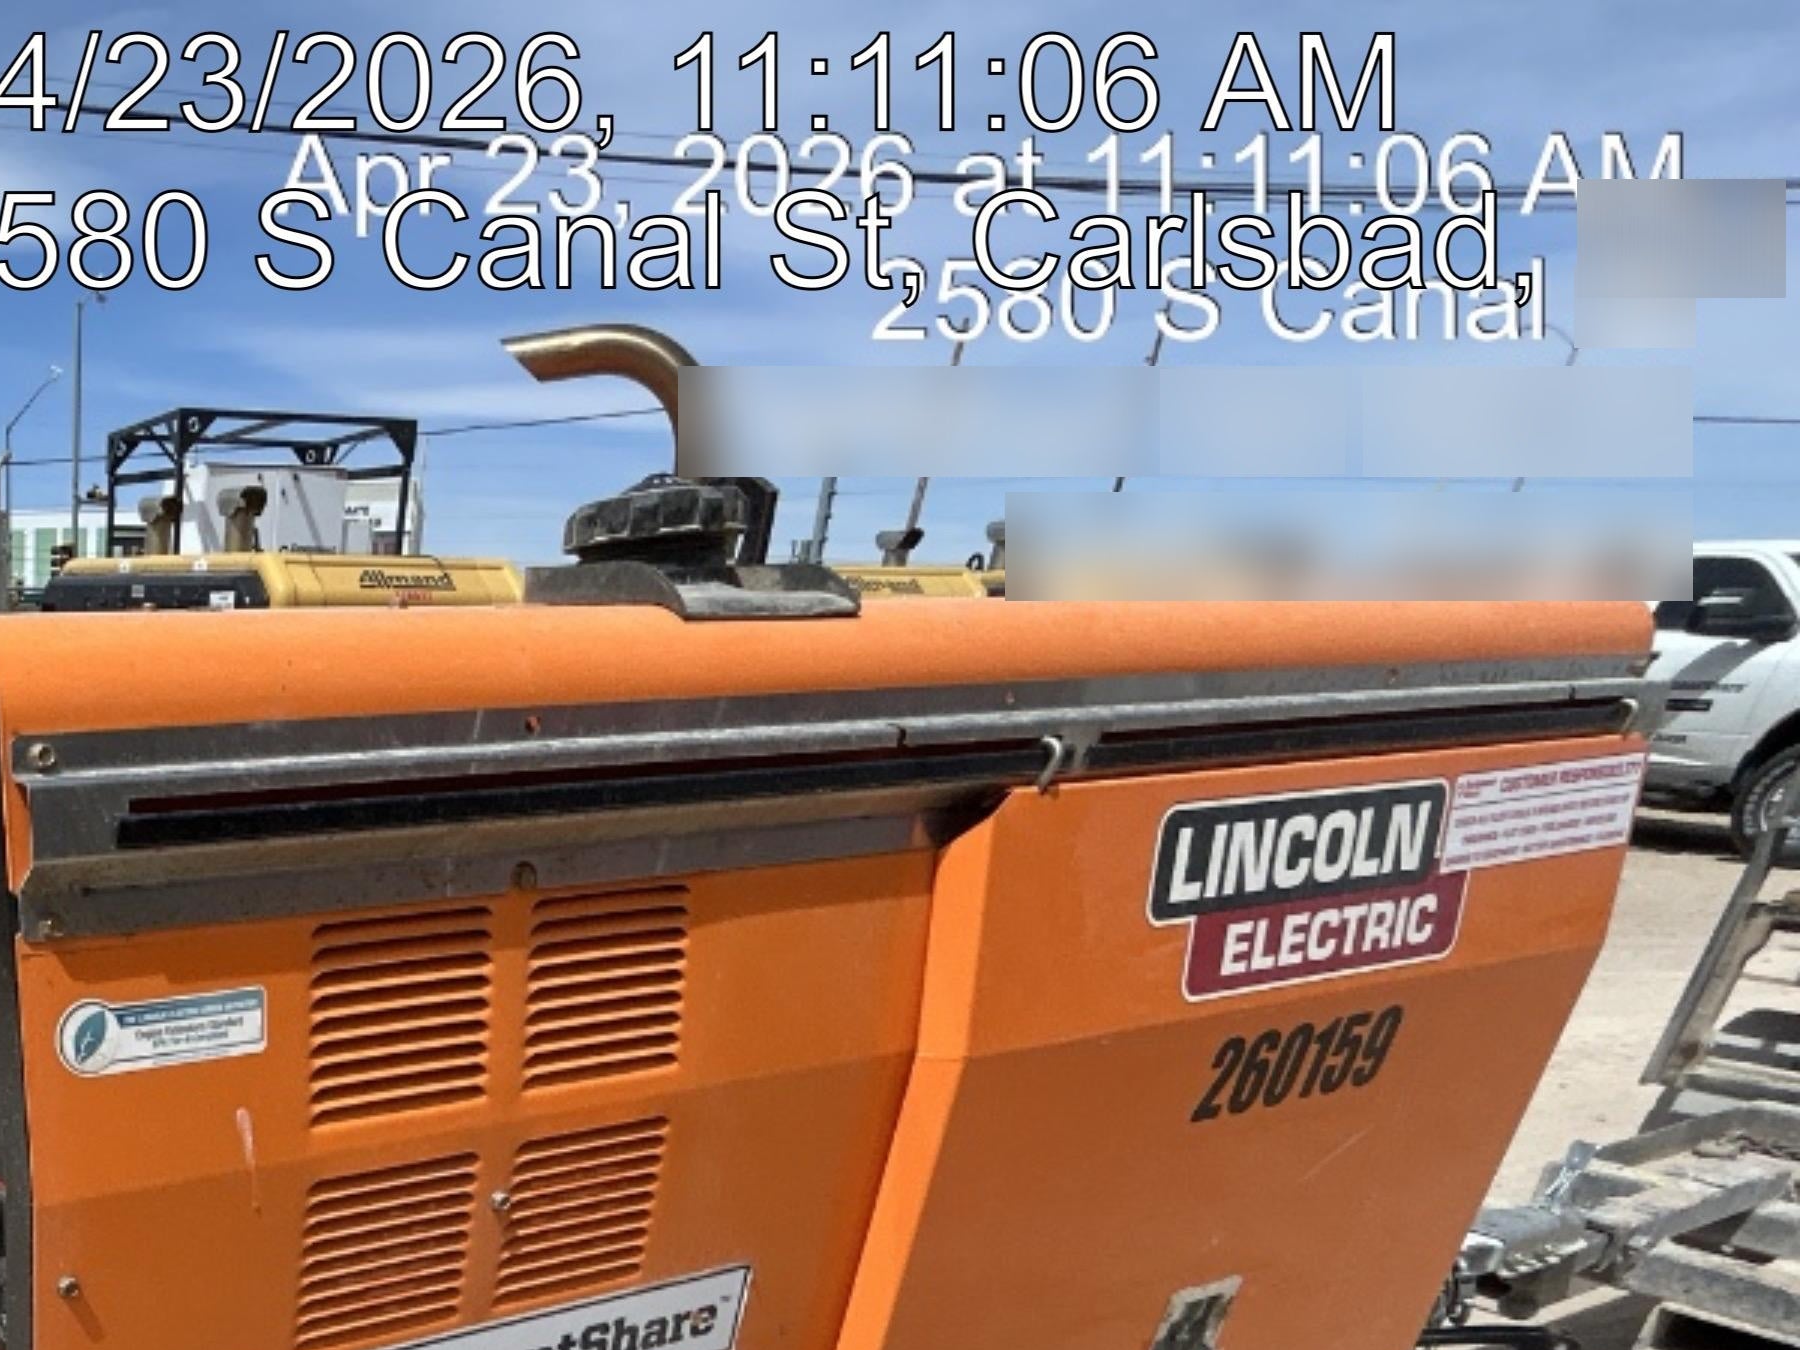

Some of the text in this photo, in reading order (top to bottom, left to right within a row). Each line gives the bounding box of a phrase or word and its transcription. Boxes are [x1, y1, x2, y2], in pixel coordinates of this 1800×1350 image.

[1167, 799, 1434, 905] LINCOLN
[1219, 891, 1439, 978] ELECTRIC
[1189, 1003, 1406, 1124] 260159
